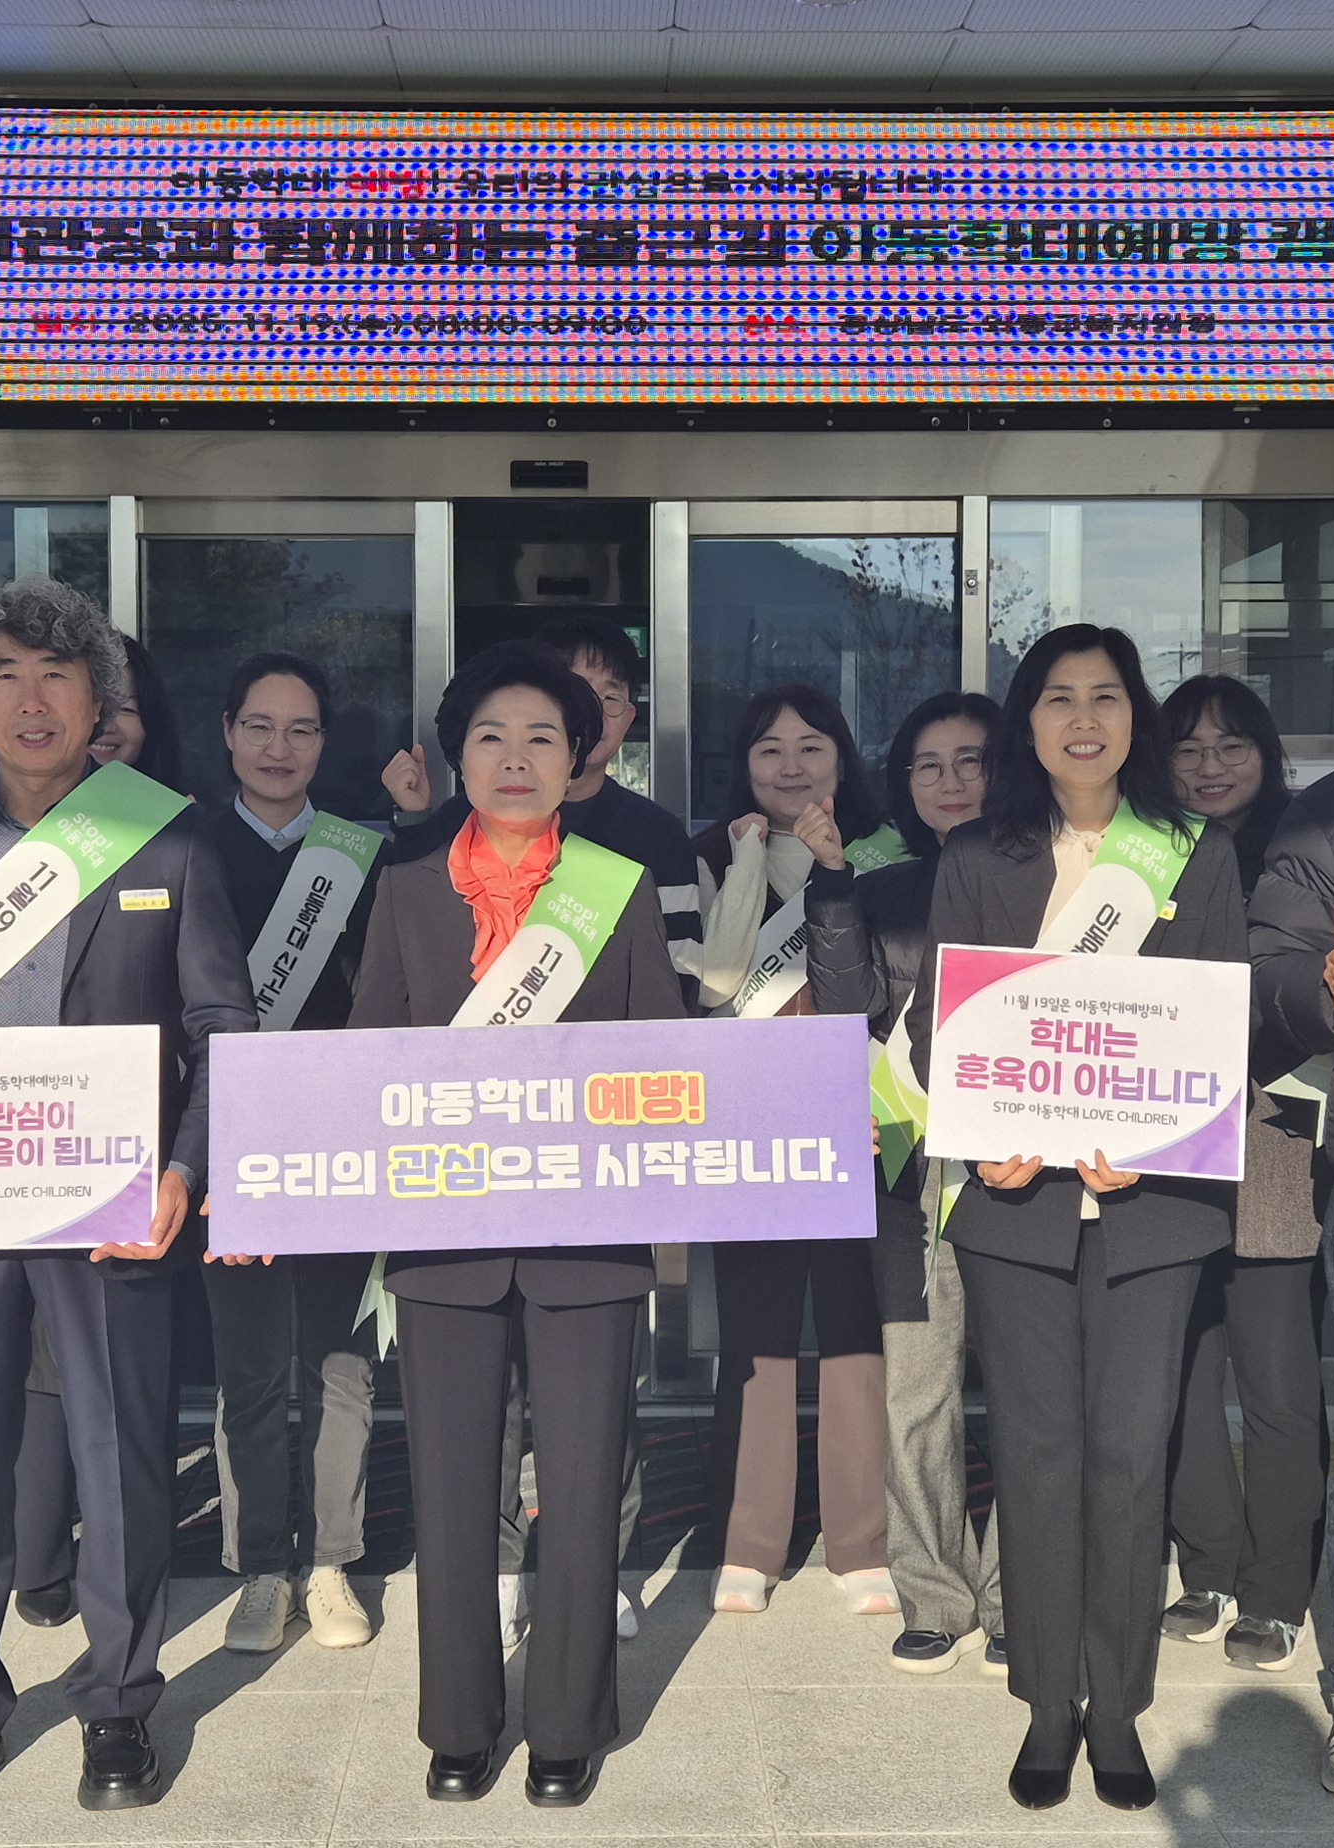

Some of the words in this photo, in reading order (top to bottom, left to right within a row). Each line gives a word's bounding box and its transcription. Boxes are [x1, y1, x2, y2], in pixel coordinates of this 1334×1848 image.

[264, 217, 551, 266] 함께하는
[57, 817, 107, 869] 아동학대
[73, 812, 114, 852] stop!
[320, 829, 368, 856] 아동학대
[329, 825, 366, 842] stop!
[1126, 833, 1169, 865] stop!
[1116, 840, 1168, 882] 아동학대
[7, 861, 58, 912] 11월
[286, 875, 334, 951] 아동학대
[547, 900, 598, 943] 아동학대
[558, 893, 600, 925] stop!
[255, 950, 298, 1014] 신고는
[519, 943, 563, 997] 11월
[1003, 994, 1030, 1011] 11월
[1034, 996, 1072, 1013] 19일은
[1074, 998, 1163, 1018] 아동학대예방의
[1166, 1004, 1180, 1021] 날
[1030, 1017, 1138, 1058] 학대는
[77, 1074, 90, 1090] 날
[380, 1077, 575, 1127] 아동학대
[584, 1071, 707, 1125] 예방!
[955, 1053, 1062, 1095] 훈육이
[1074, 1062, 1221, 1107] 아닙니다
[992, 1101, 1025, 1114] STOP
[1028, 1103, 1079, 1120] 아동학대
[1082, 1109, 1114, 1122] LOVE
[1117, 1111, 1178, 1126] CHILDREN
[53, 1135, 145, 1167] 됩니다
[236, 1149, 377, 1199] 우리의
[387, 1141, 582, 1199] 관심으로
[595, 1136, 849, 1189] 시작됩니다.
[31, 1185, 92, 1199] CHILDREN
